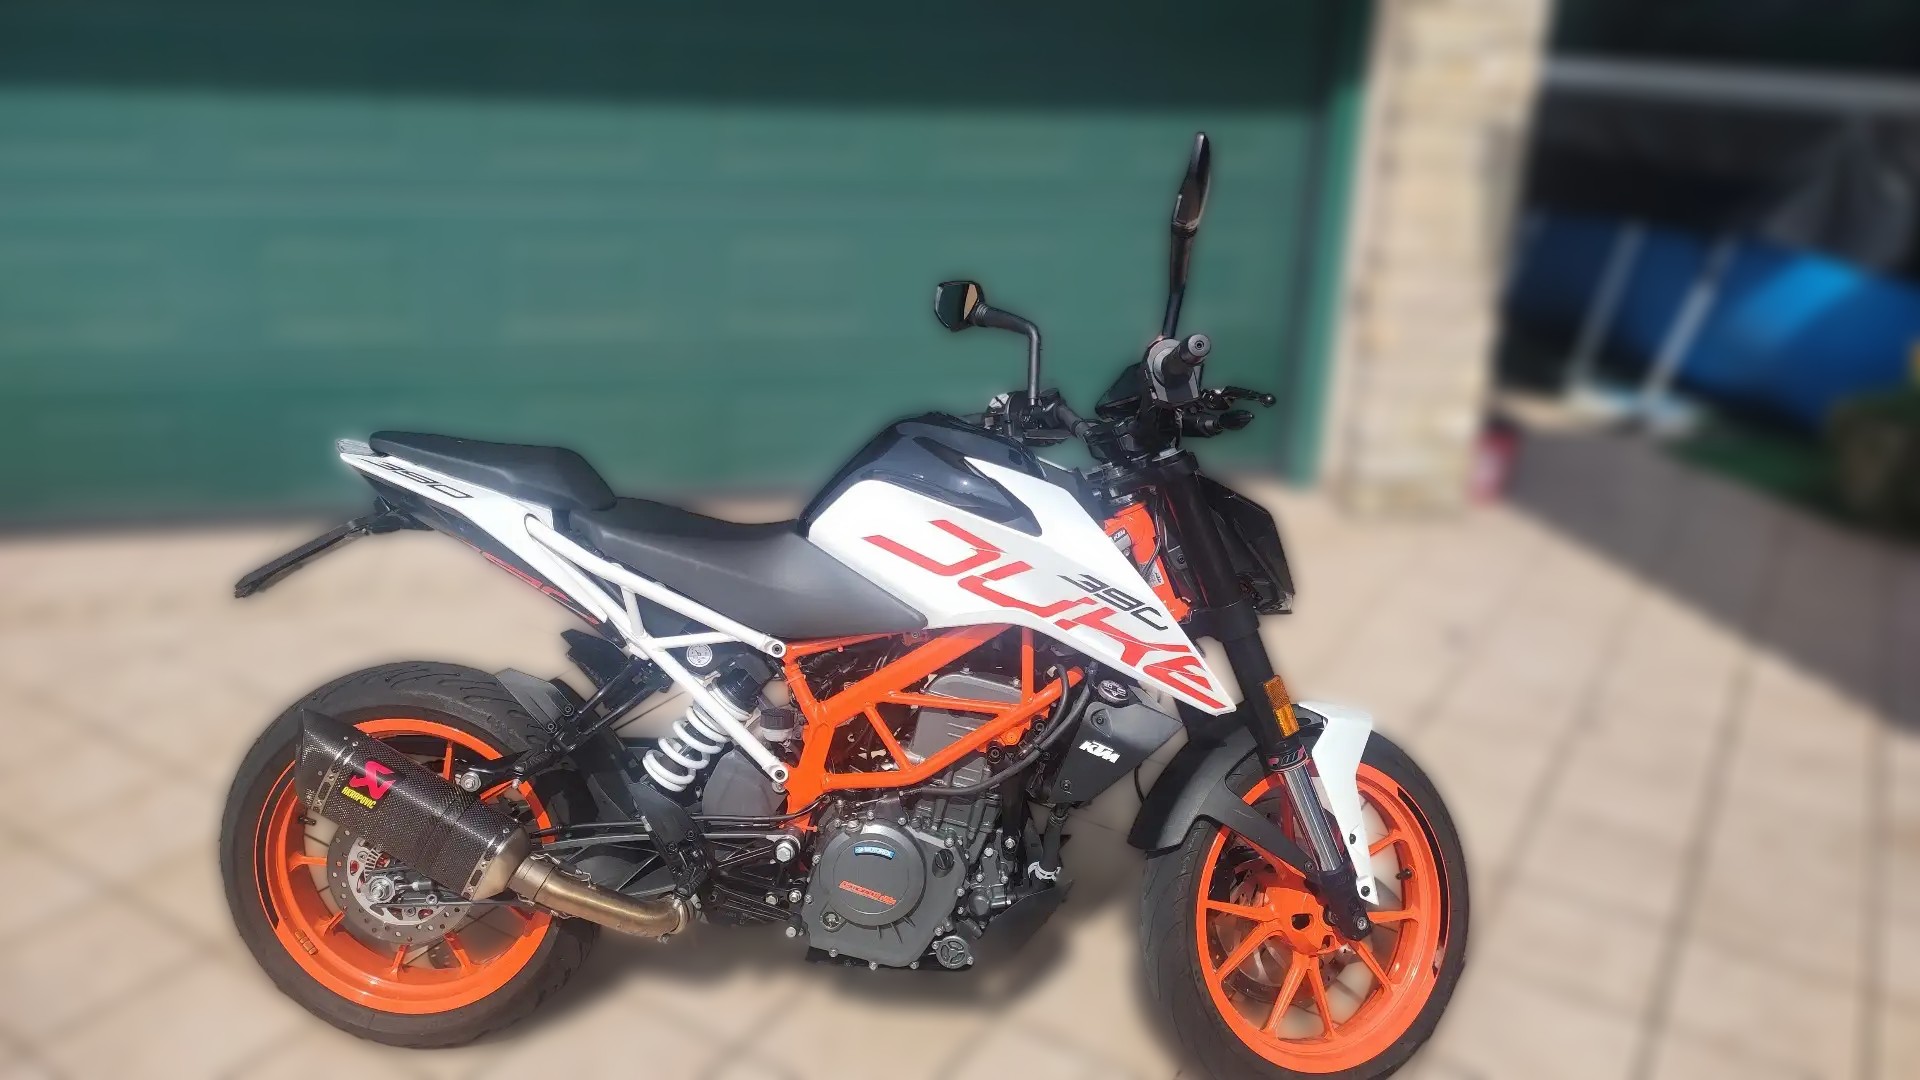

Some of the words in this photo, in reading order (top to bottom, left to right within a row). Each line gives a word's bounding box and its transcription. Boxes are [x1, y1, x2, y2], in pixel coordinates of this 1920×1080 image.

[360, 458, 474, 498] 390
[862, 519, 1226, 709] DUKE
[1057, 574, 1168, 631] 390
[1079, 740, 1120, 763] KTM
